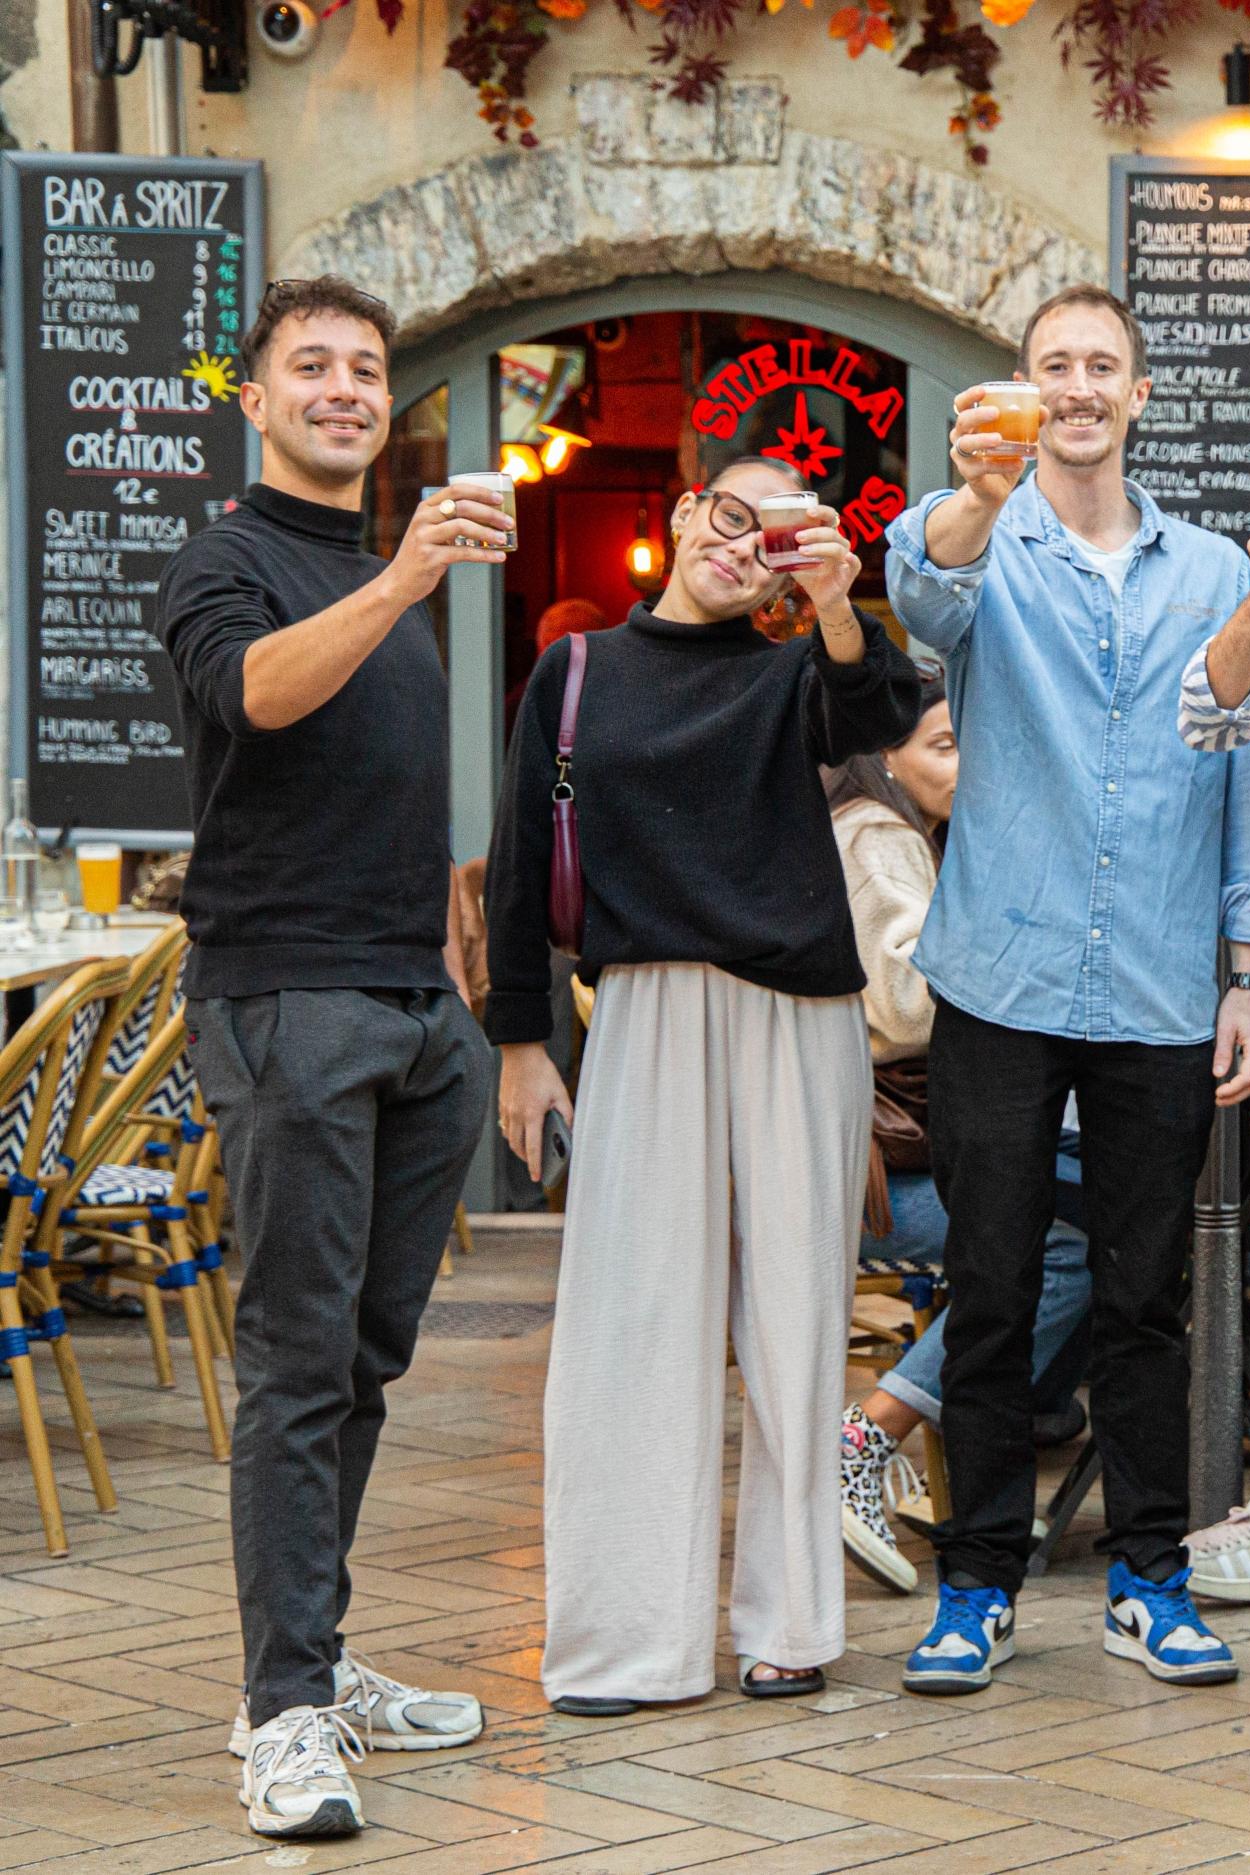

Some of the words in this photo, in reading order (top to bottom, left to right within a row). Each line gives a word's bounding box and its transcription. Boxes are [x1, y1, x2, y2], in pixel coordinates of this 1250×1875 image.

[45, 176, 110, 227] BAR
[1136, 220, 1203, 244] PLANCHE
[195, 240, 210, 262] 8
[43, 257, 156, 282] LIMONCELLO
[193, 264, 208, 286] 9
[1136, 257, 1203, 282] PLANCHE
[192, 287, 207, 310] 9
[1135, 292, 1202, 317] PLANCHE
[43, 301, 62, 322] LE
[182, 309, 204, 330] 11
[181, 330, 205, 351] 13
[69, 376, 210, 411] COCKTAILS
[692, 339, 904, 440] STELLA
[121, 408, 137, 430] &
[66, 428, 205, 475] CRÉATIONS
[44, 508, 110, 538] SWEET
[120, 513, 188, 540] MIMOSA
[41, 596, 143, 625] ARLEQUIN
[38, 715, 120, 743] HUMMING
